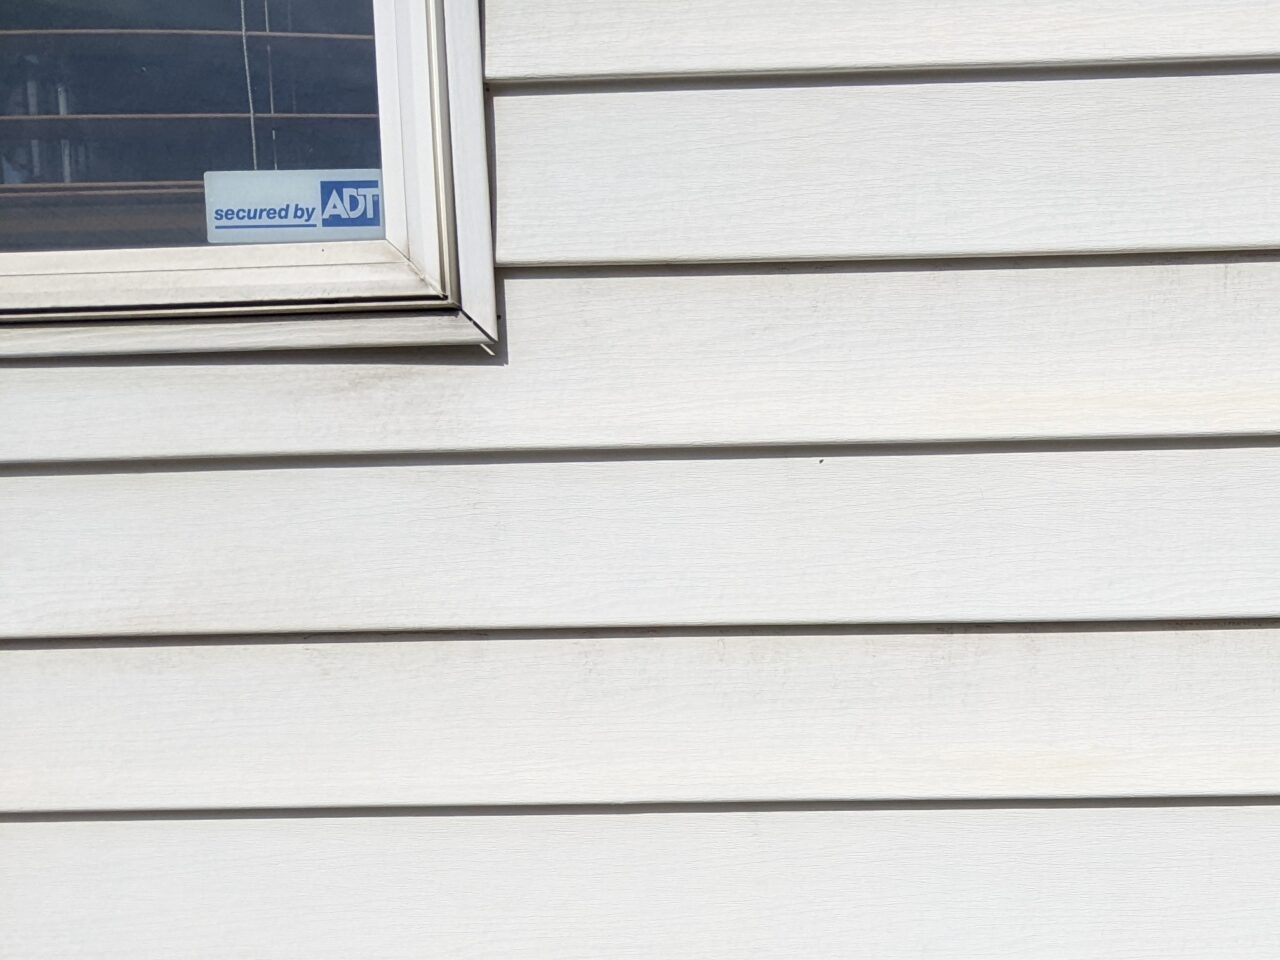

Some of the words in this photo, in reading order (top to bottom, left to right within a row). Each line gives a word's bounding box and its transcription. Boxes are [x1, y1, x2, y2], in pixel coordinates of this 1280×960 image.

[214, 204, 290, 221] secured
[293, 203, 316, 222] by
[322, 188, 380, 219] ADT
